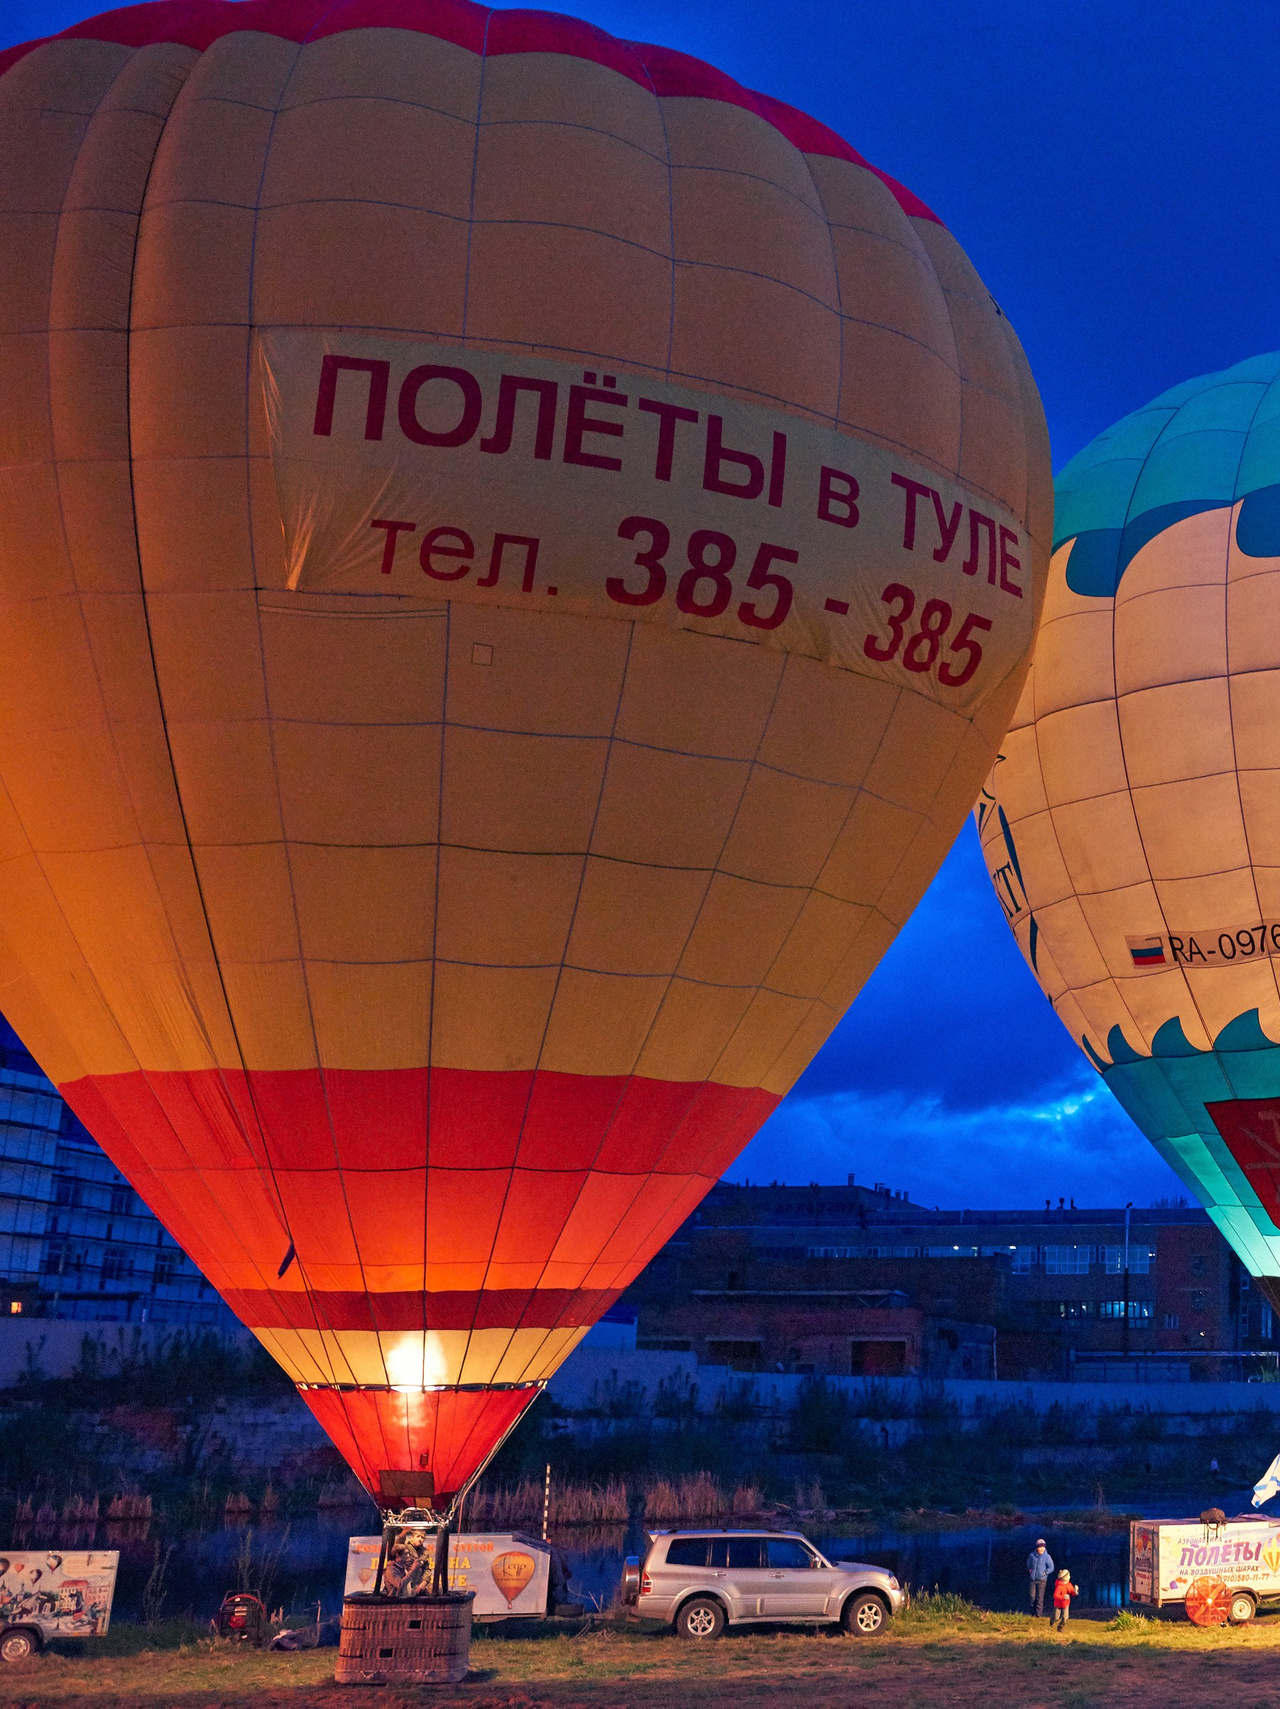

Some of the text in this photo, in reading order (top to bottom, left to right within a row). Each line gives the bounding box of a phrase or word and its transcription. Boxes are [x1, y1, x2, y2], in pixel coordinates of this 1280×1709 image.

[313, 355, 1024, 598] ПОЛЁТЫ в ТУЛЕ
[370, 519, 559, 596] тел.
[605, 516, 800, 631] 385
[863, 583, 993, 688] 385
[1179, 1538, 1262, 1567] ПОЛЁТЫ
[1190, 1566, 1234, 1576] ВОЗДУШНЫХ
[1235, 1565, 1260, 1573] ШАРАХ
